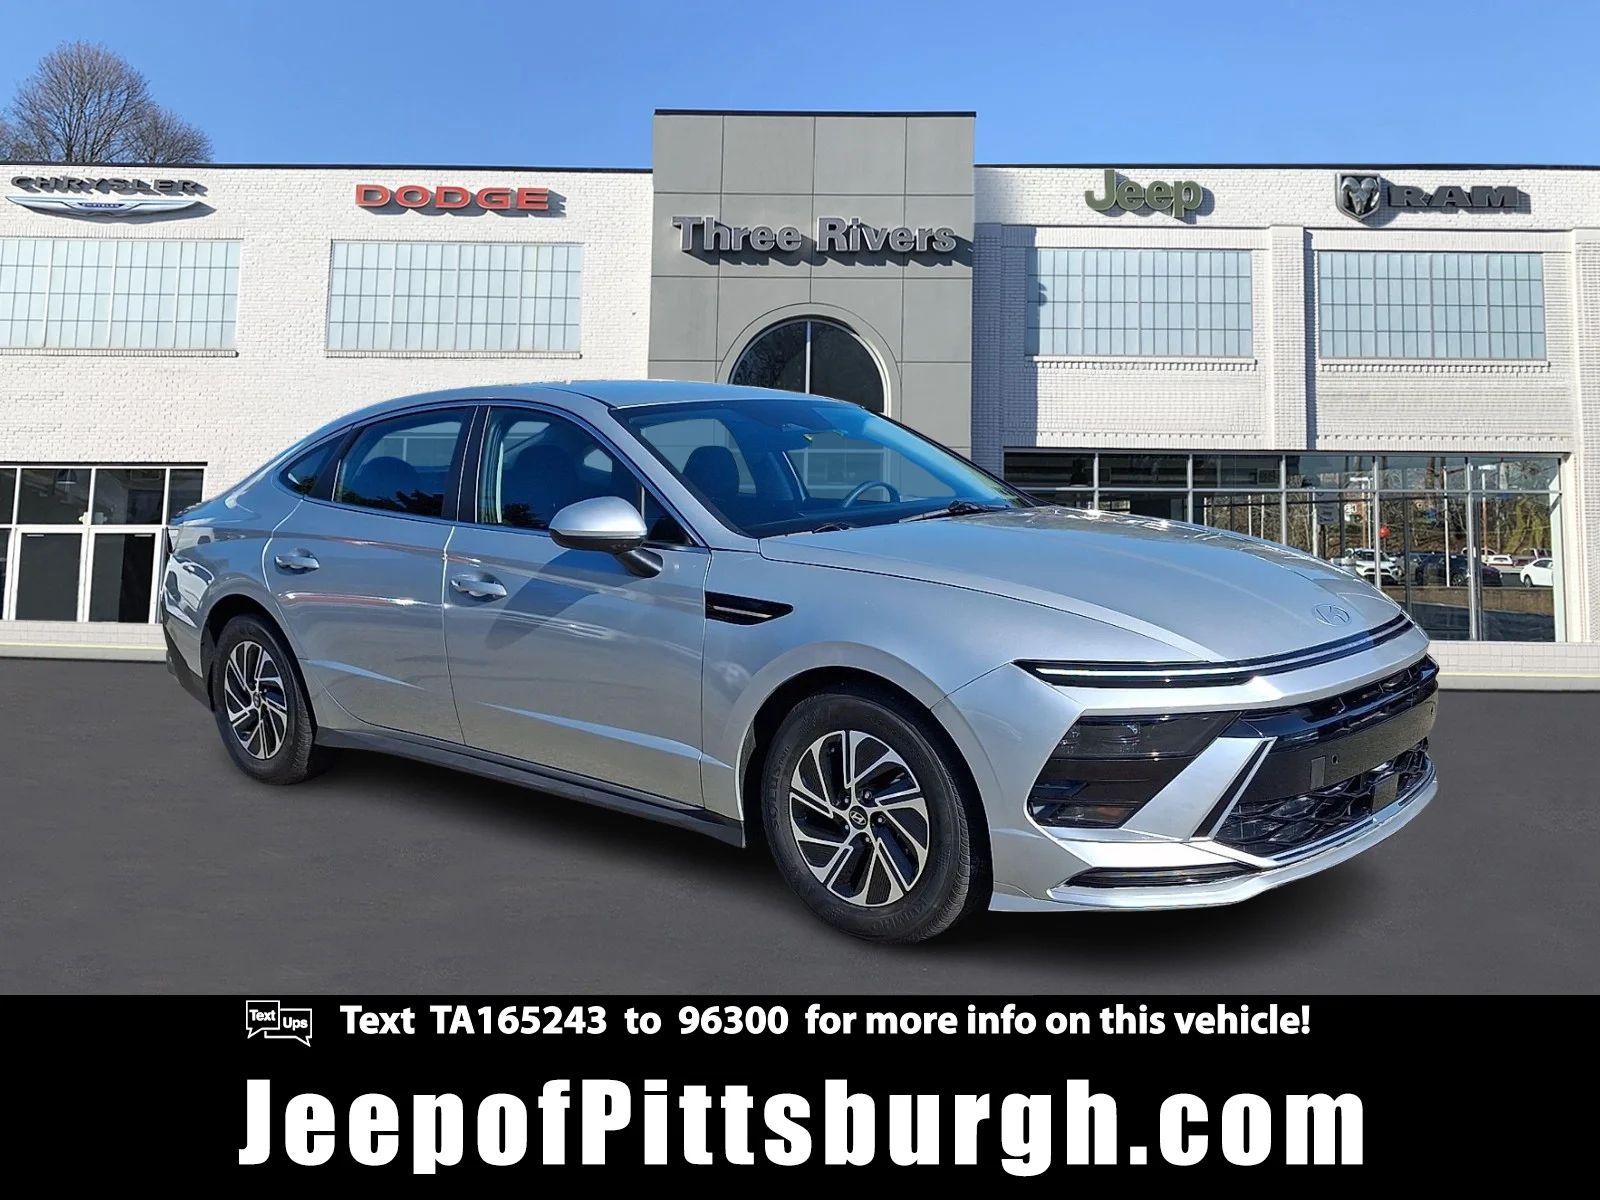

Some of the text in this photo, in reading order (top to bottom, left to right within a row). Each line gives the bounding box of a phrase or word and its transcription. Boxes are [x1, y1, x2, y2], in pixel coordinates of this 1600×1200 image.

[11, 175, 197, 192] CHRYSLER
[1085, 169, 1203, 218] Jeep
[355, 184, 549, 210] DODGE
[1388, 186, 1520, 208] RAM
[671, 216, 957, 252] Three Rivers
